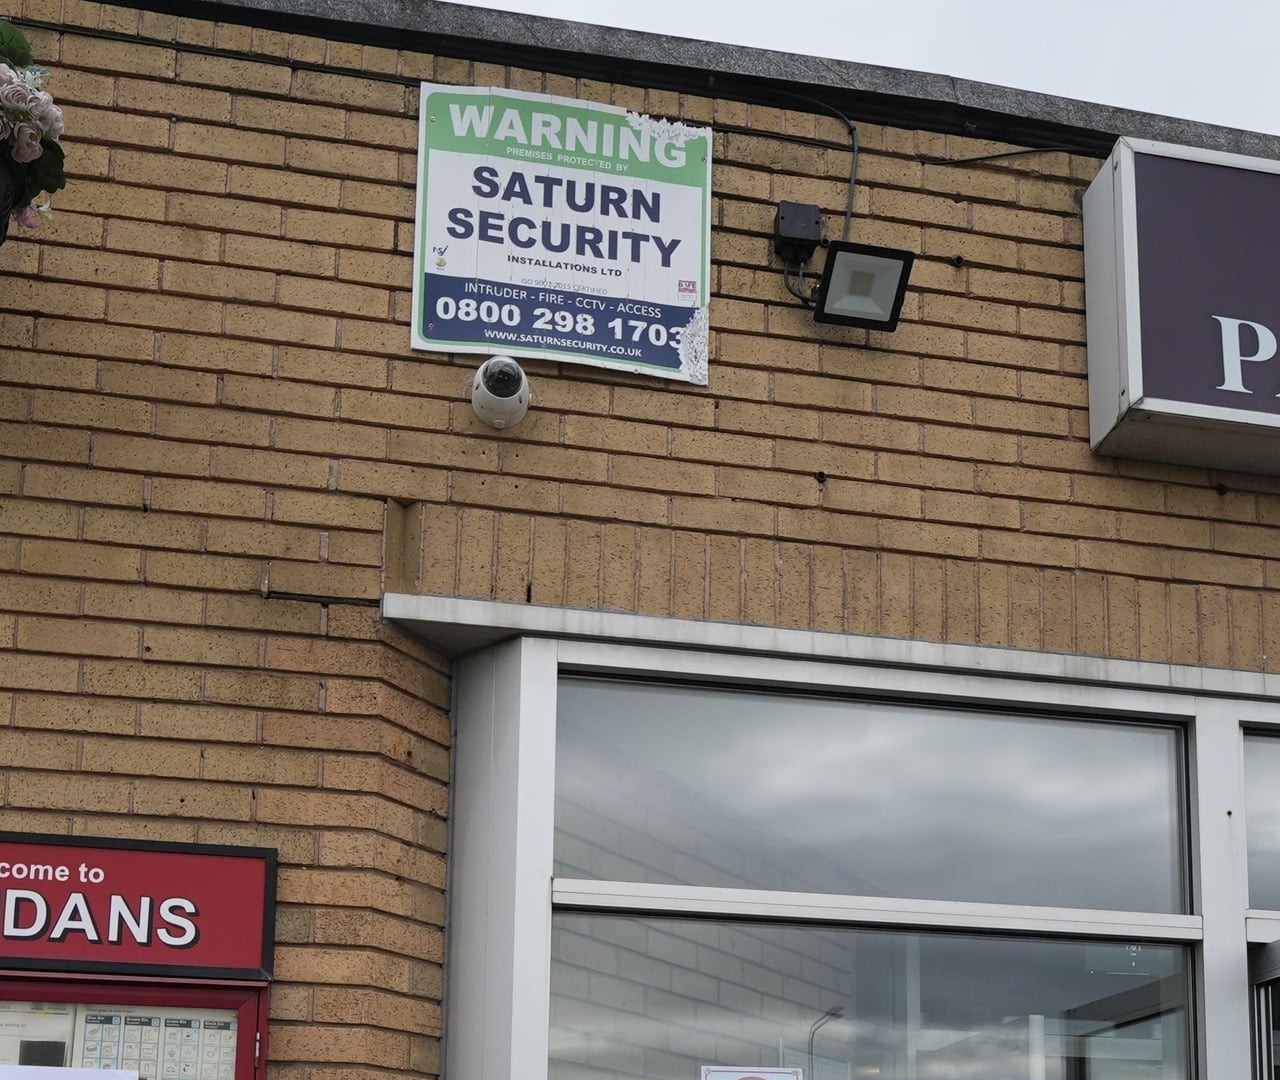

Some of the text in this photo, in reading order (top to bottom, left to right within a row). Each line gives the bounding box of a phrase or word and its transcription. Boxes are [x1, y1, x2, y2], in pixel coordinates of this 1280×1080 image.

[448, 103, 687, 168] WARNING
[506, 146, 628, 172] PREMISES PROTECTED BY
[472, 166, 661, 223] SATURN
[446, 207, 682, 268] SECURITY
[507, 254, 622, 277] INSTALLATIONS LTD
[464, 282, 661, 318] INTRUDER FIRE CCTV ACCESS
[521, 278, 532, 286] ISO
[573, 284, 608, 295] CERTIFIED
[436, 296, 686, 348] 0800 298 1703
[484, 329, 642, 357] WWW.SATURNSECURITY.CO.UK
[78, 862, 105, 883] to
